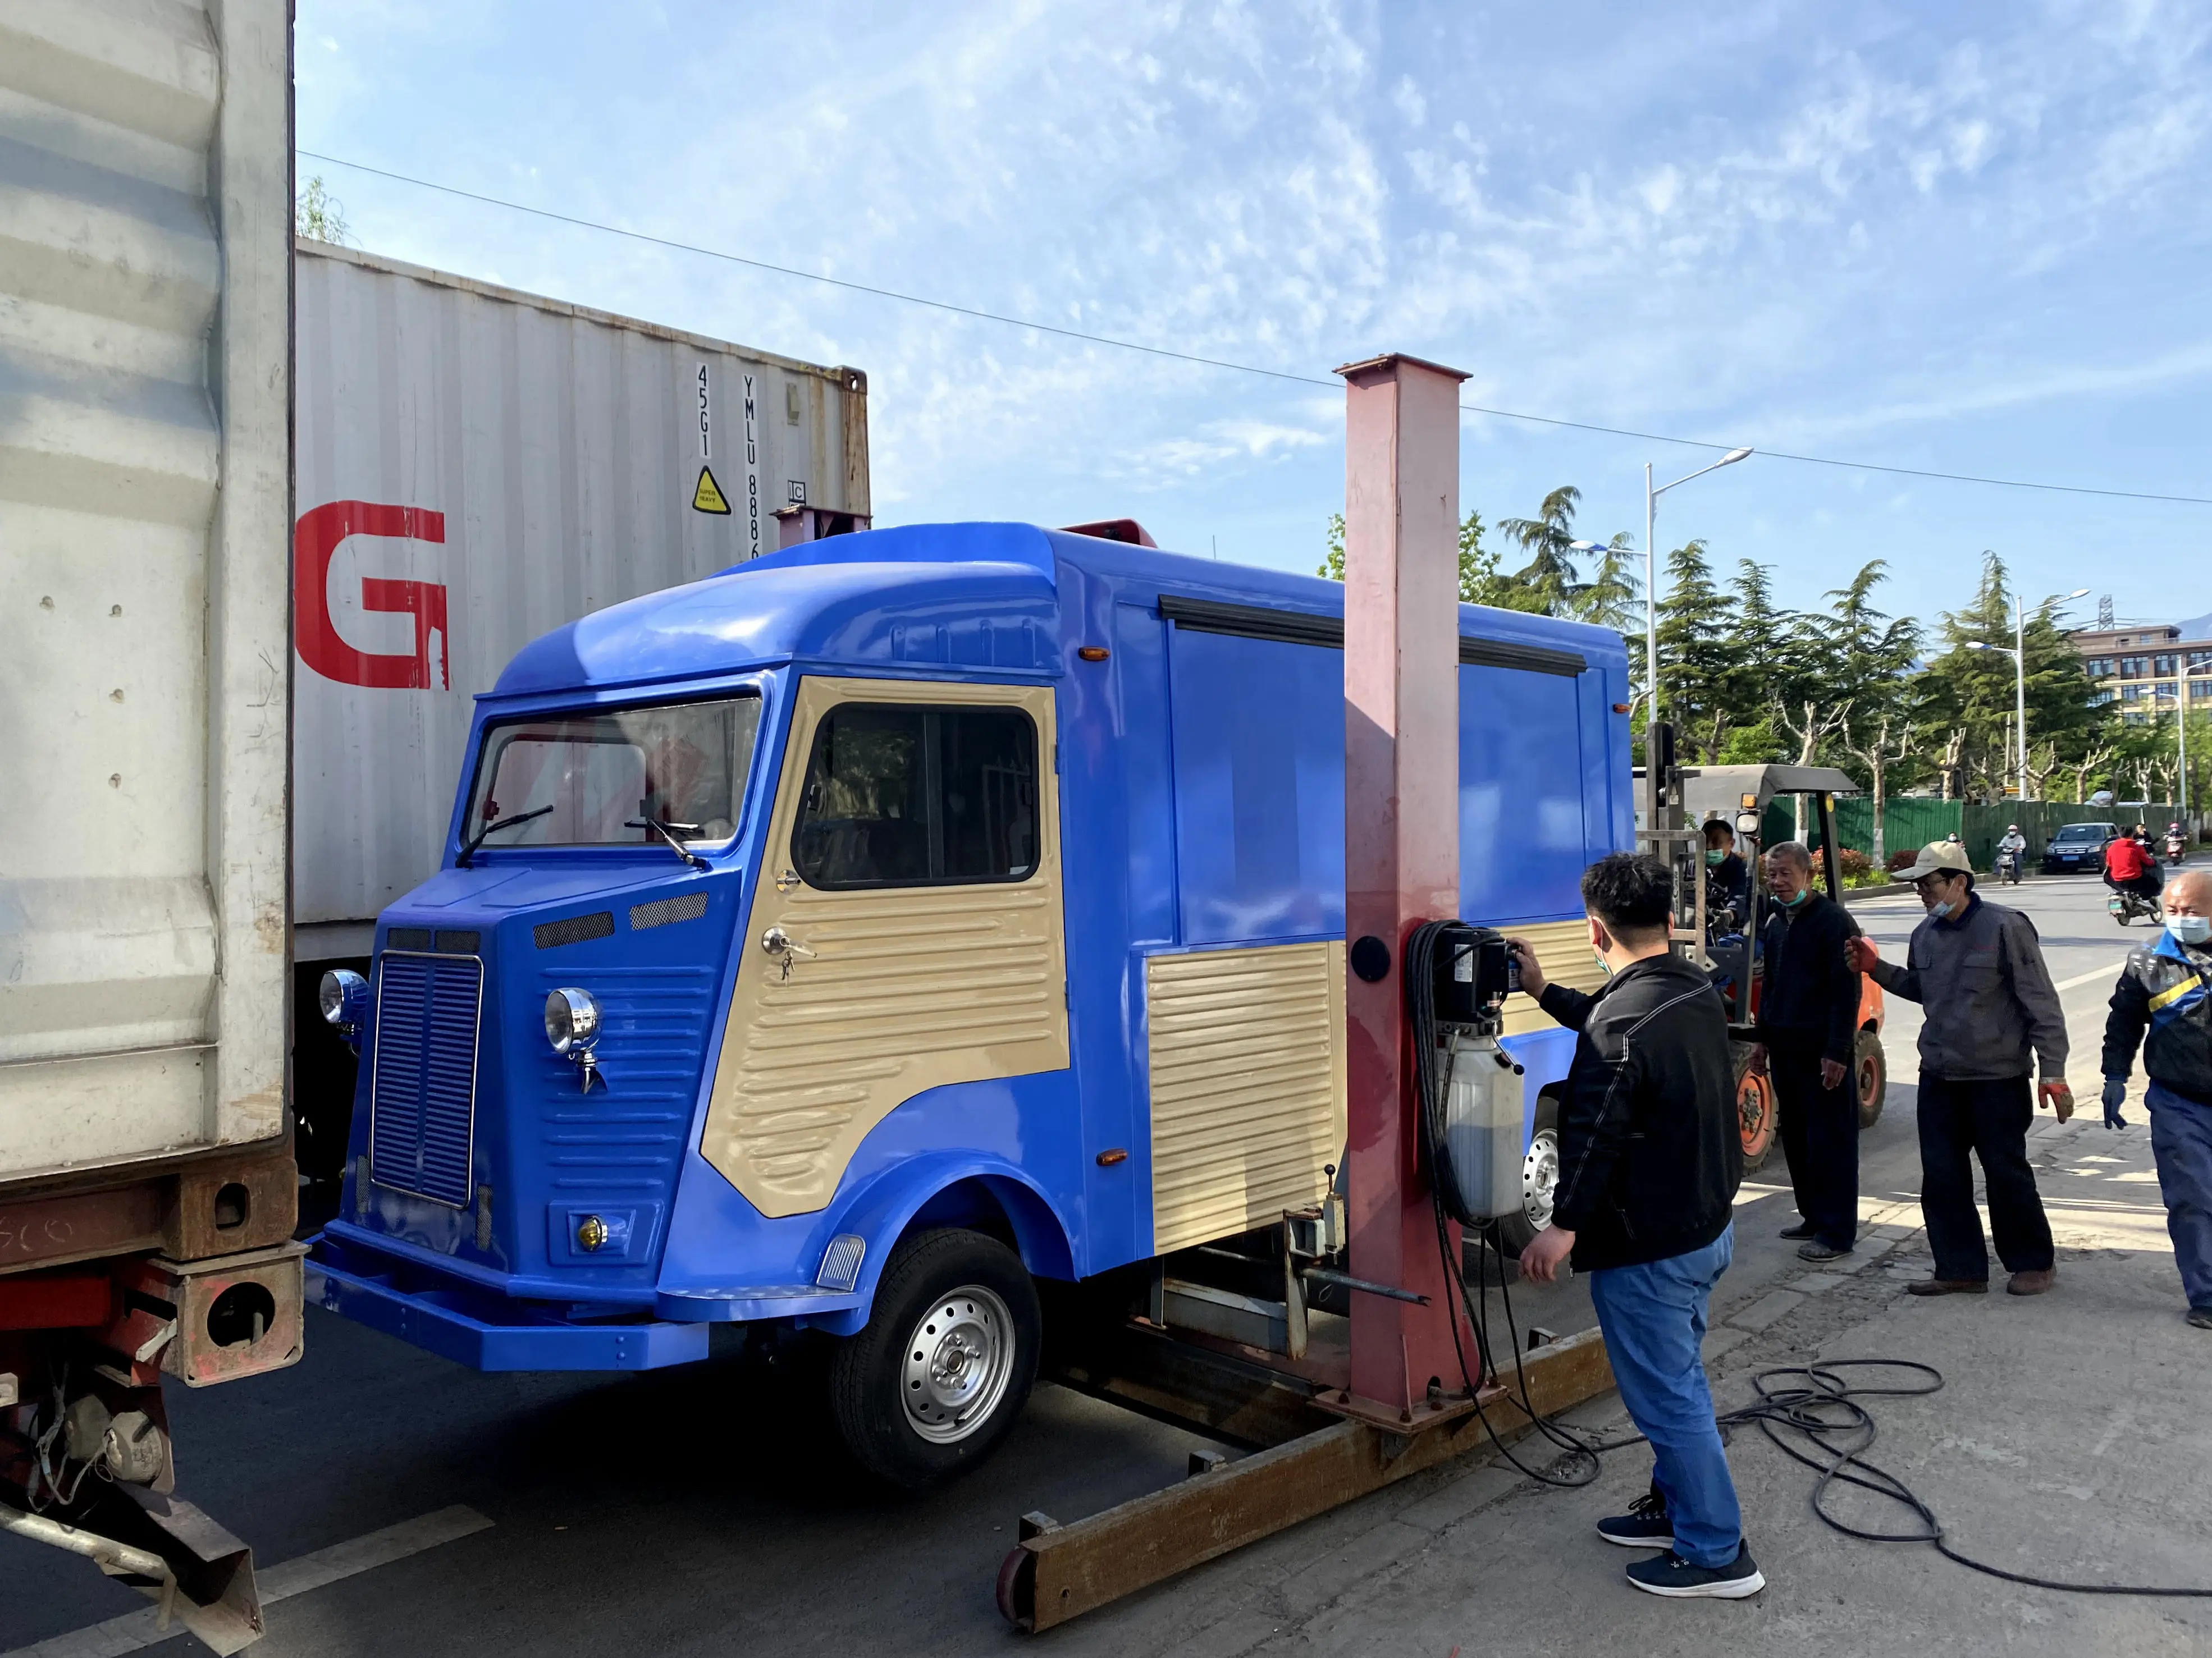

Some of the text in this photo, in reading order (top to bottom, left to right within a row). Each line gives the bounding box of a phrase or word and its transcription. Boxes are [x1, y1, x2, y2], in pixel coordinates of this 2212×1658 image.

[698, 365, 709, 456] 45G1
[744, 375, 758, 559] YMLU 8886
[294, 500, 449, 691] G
